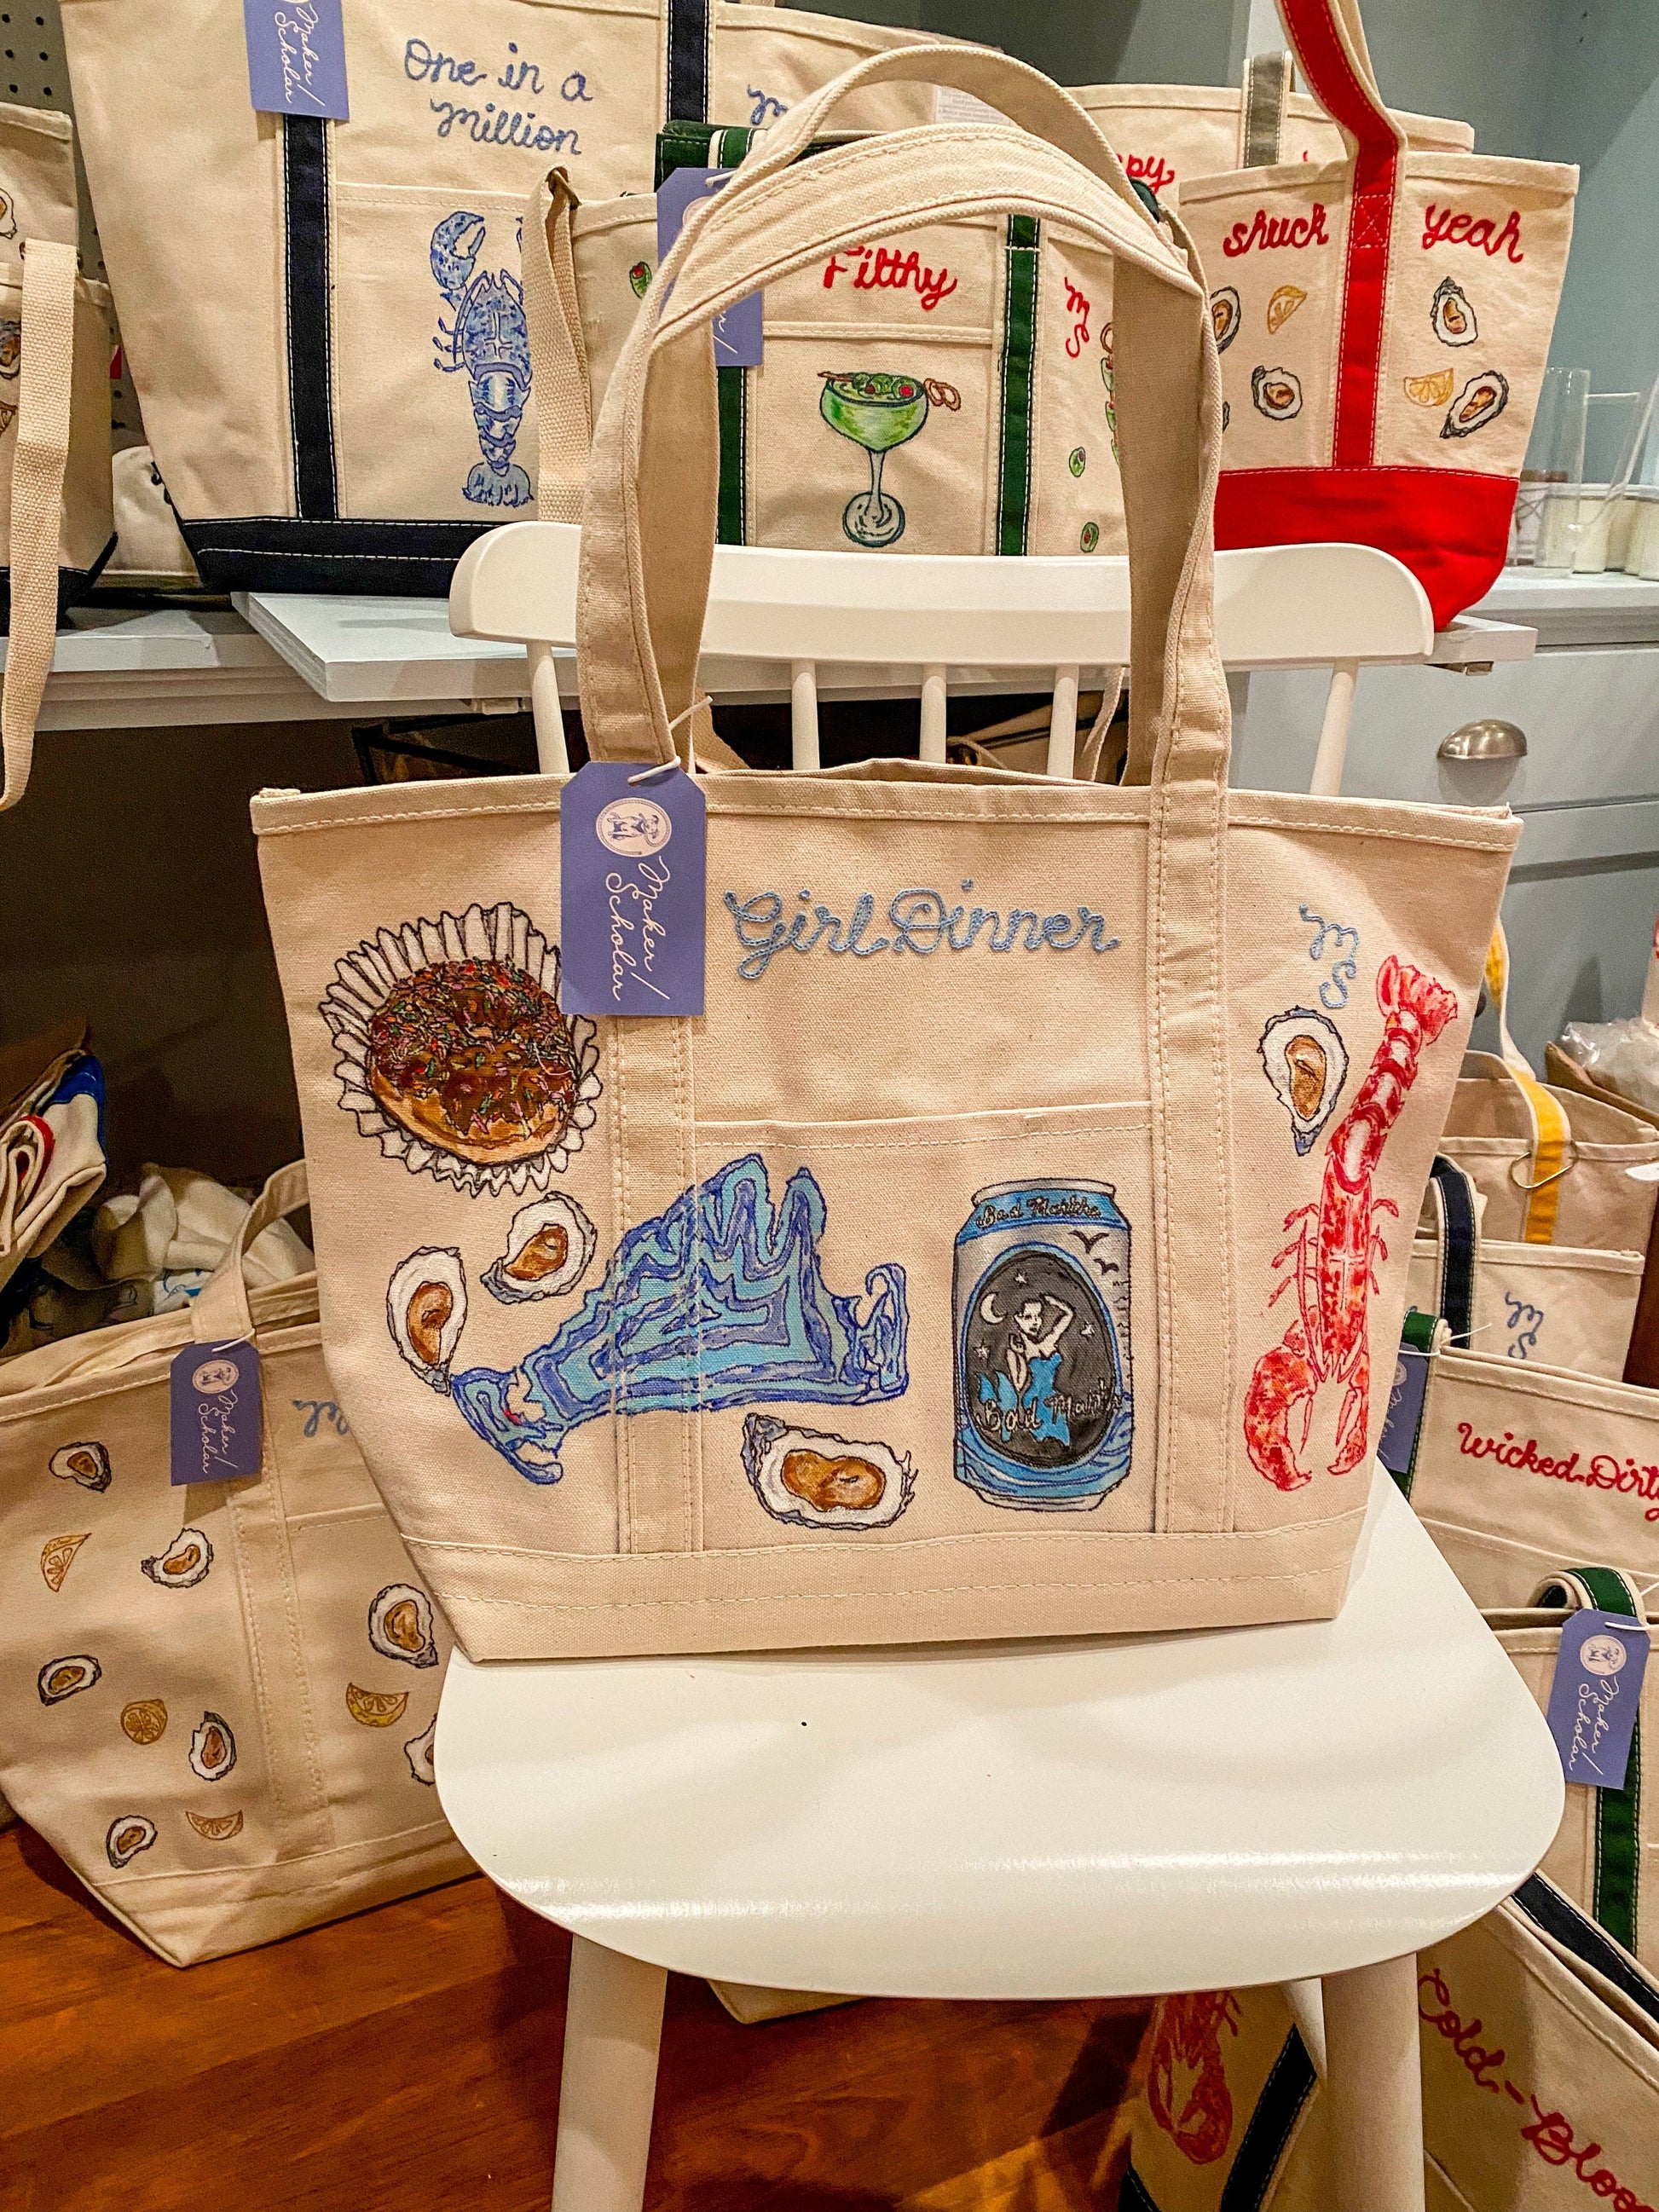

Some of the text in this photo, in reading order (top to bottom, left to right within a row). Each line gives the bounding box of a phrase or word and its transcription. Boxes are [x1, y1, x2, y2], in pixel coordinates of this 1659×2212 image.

[275, 11, 301, 103] Scholar
[404, 38, 594, 101] One in a
[430, 98, 582, 155] million
[1223, 202, 1329, 257] shuck
[1422, 203, 1524, 263] yeah
[824, 245, 958, 310] Filthy
[605, 872, 640, 1002] Scholar
[723, 878, 1121, 980] Girl Dinner
[198, 1403, 220, 1474] Scholar
[1458, 1422, 1586, 1483] Wicked
[1569, 1683, 1598, 1771] Scholar
